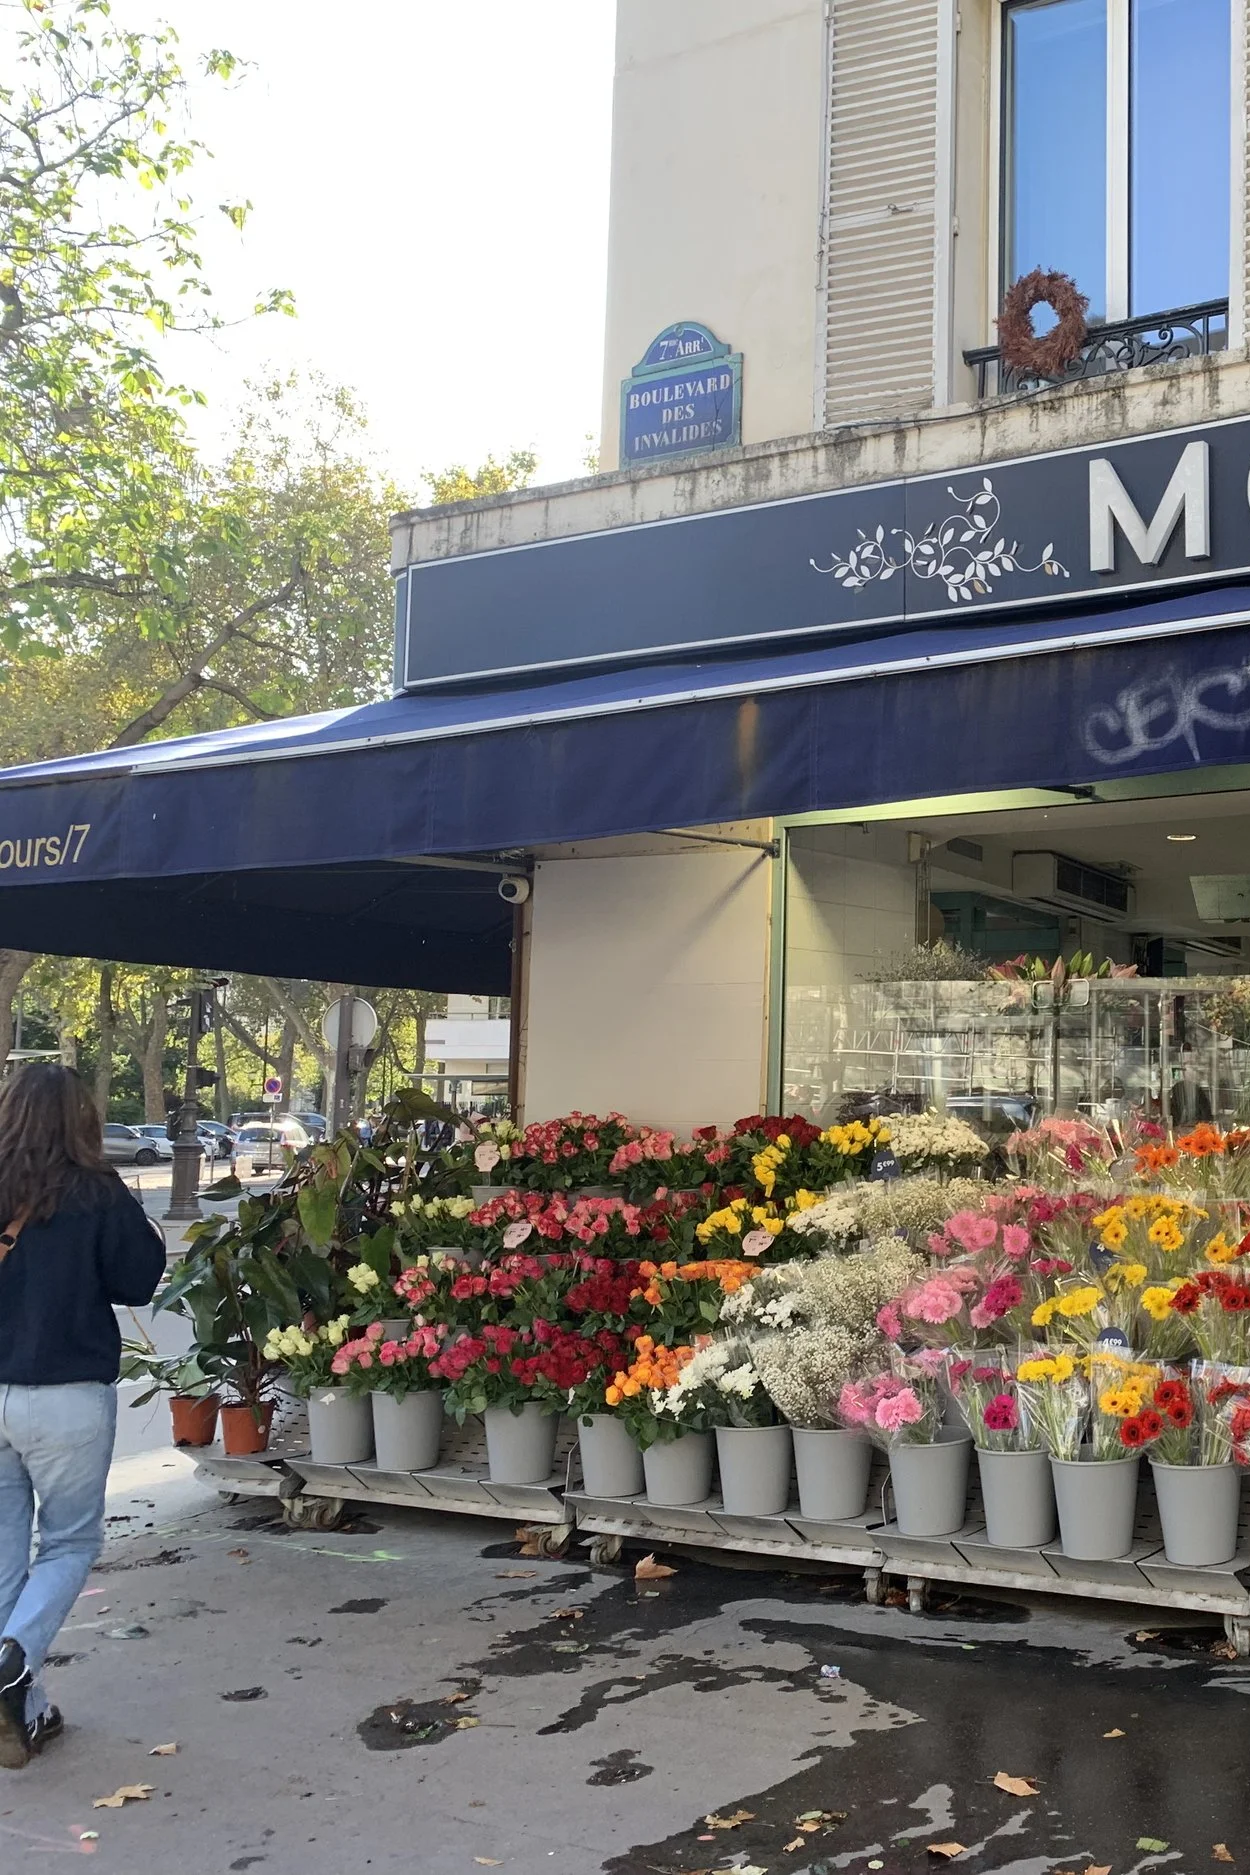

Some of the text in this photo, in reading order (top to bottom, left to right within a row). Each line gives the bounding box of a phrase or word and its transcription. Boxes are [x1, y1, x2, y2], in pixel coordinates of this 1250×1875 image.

[629, 373, 731, 409] BOULEVARD
[662, 403, 695, 424] DES
[634, 419, 722, 452] INVALIDES
[877, 1160, 895, 1171] 5€99
